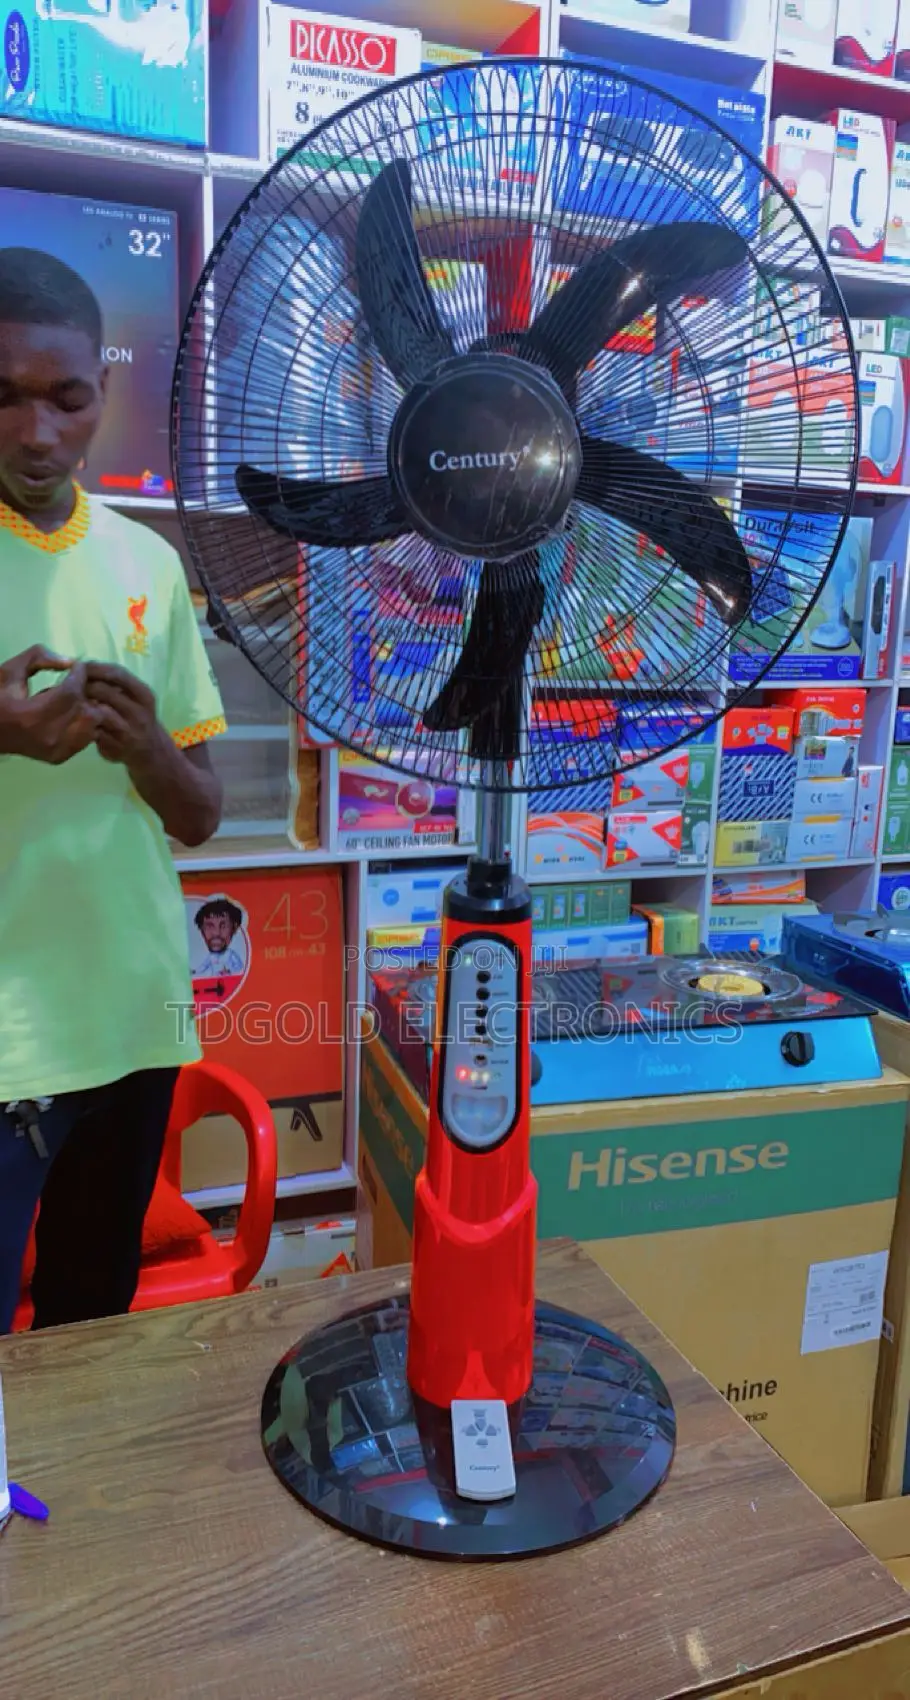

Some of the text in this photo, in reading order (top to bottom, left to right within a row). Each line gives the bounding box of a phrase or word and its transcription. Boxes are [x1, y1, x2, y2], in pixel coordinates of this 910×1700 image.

[296, 24, 387, 71] PICASSO
[290, 63, 340, 81] ALUMINIUM
[295, 102, 309, 124] 8
[101, 346, 133, 363] ION
[429, 450, 522, 471] Century
[364, 836, 401, 849] CEILING
[403, 835, 420, 847] FAN
[263, 889, 329, 941] 43
[567, 1140, 789, 1191] Hisense
[719, 1379, 778, 1402] hine
